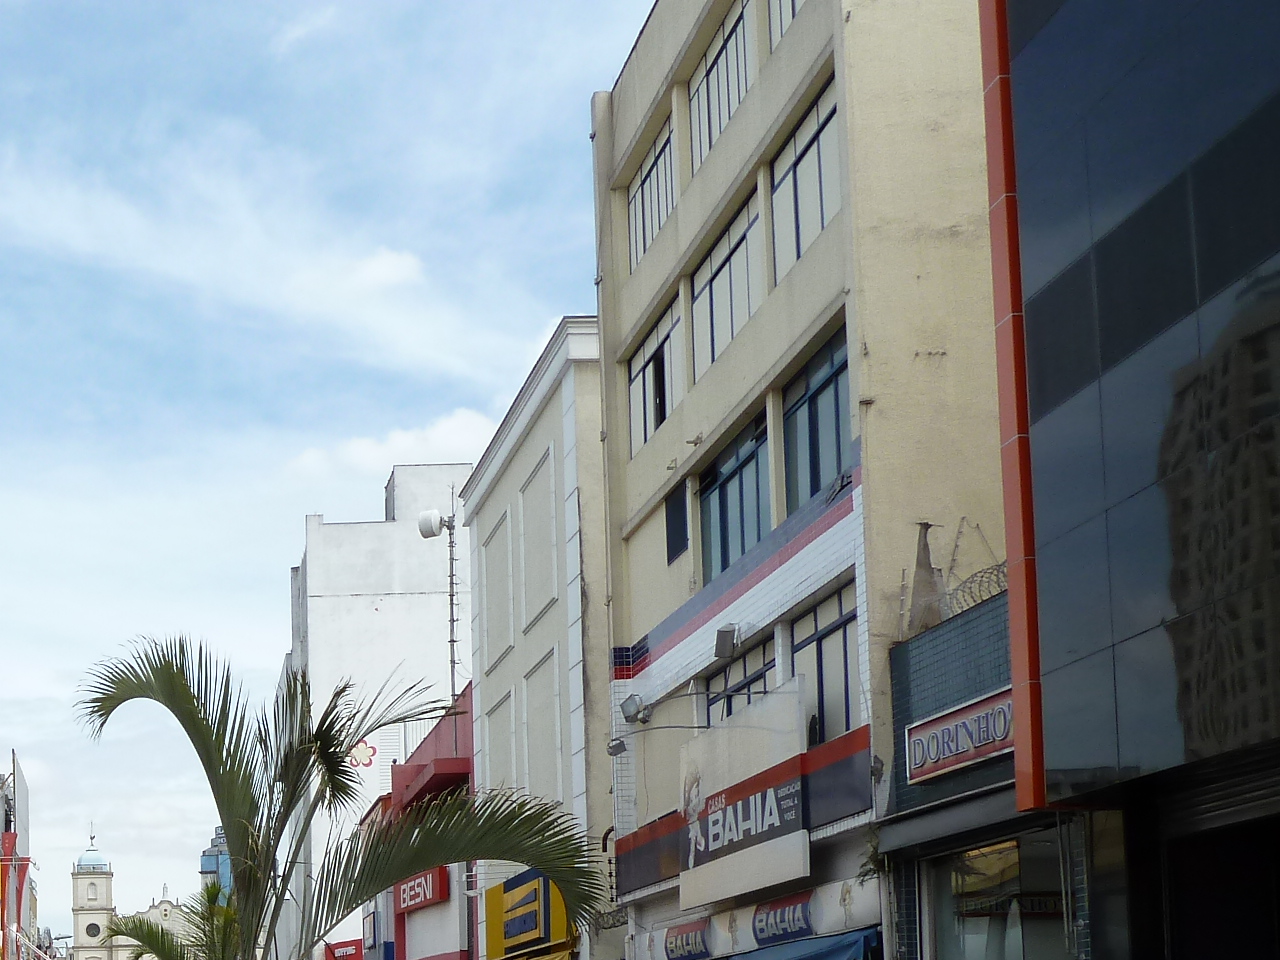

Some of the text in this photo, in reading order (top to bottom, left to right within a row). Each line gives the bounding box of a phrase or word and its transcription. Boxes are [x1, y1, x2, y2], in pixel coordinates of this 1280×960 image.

[708, 793, 726, 815] CASAS
[708, 788, 781, 852] BAHIA
[400, 873, 433, 909] BESNI
[755, 903, 808, 940] BAHIA
[667, 930, 706, 959] BAHIA
